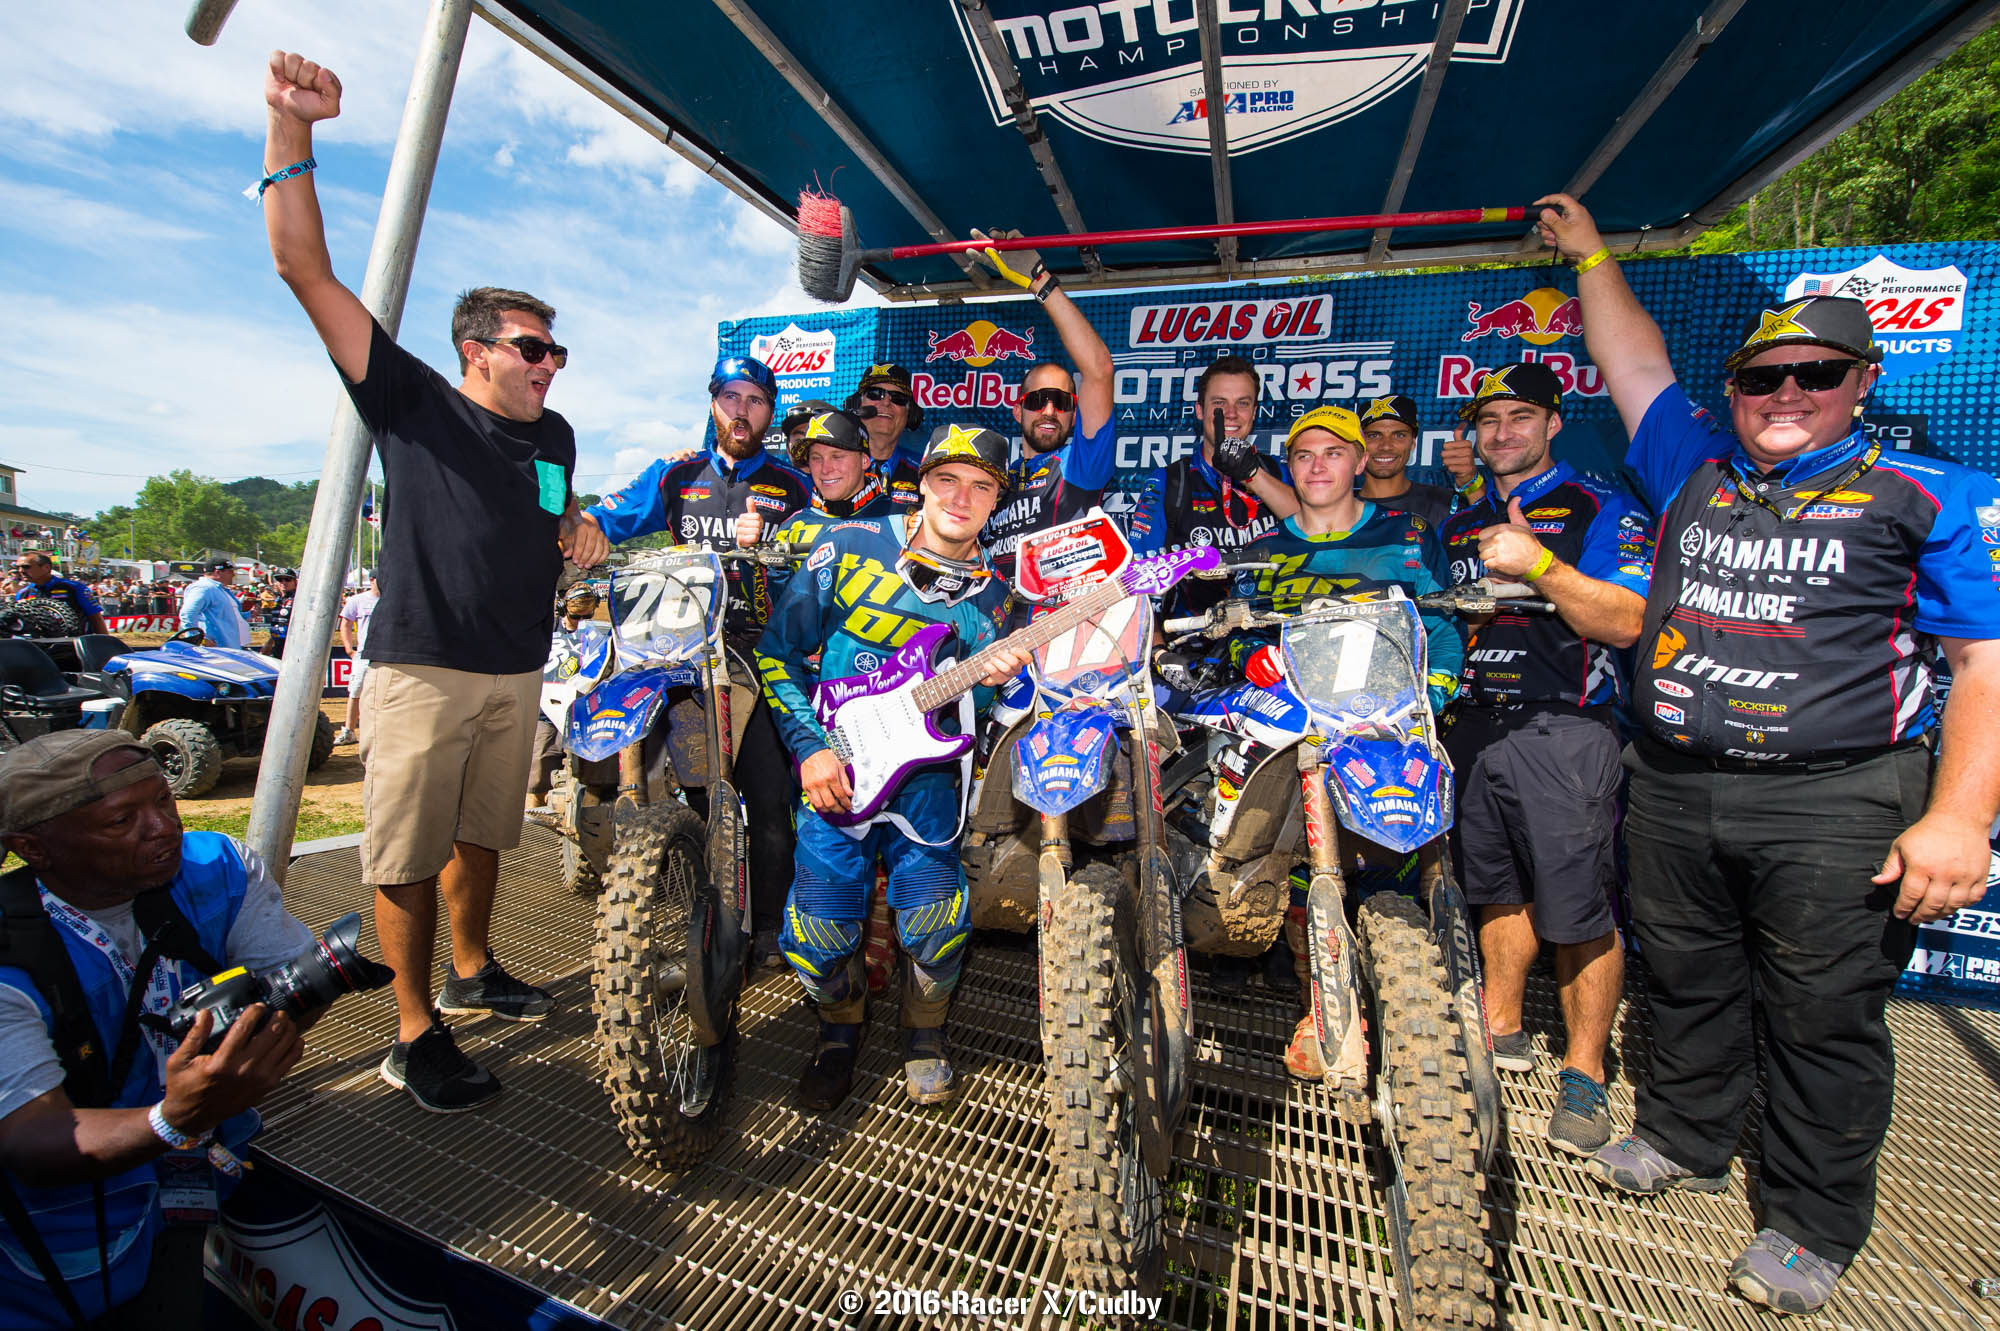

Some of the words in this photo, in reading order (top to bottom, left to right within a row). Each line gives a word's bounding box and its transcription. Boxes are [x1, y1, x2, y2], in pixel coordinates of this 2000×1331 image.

[1014, 0, 1491, 77] HAMPONSHIP
[1190, 81, 1260, 97] SAIONED
[1264, 80, 1279, 89] BY
[1250, 90, 1294, 106] PRO
[1250, 104, 1294, 113] RACING
[1881, 285, 1962, 294] PERFORMANCE
[1136, 303, 1257, 344] LUCAS
[1262, 298, 1324, 339] OIL
[1864, 297, 1955, 330] CAS
[1183, 347, 1268, 362] PRO
[1875, 338, 1952, 354] DUCTS
[765, 349, 831, 374] LUCAS
[776, 377, 831, 390] PRODUCTS
[1075, 360, 1394, 404] OTOROSS
[1437, 349, 1537, 399] Re
[1541, 352, 1609, 397] Bu
[781, 394, 802, 404] INC.
[912, 371, 978, 408] Red
[980, 370, 1023, 408] Bu
[990, 495, 1042, 531] YAMAHA
[701, 516, 778, 544] YAMHA
[1043, 529, 1071, 543] LUCAS
[1072, 525, 1086, 534] OIL
[1213, 514, 1279, 547] YAMAH
[1047, 543, 1074, 558] LUCAS
[1075, 539, 1089, 548] OIL
[1701, 527, 1846, 574] YAMAHA
[1680, 556, 1831, 586] RACING
[619, 566, 716, 641] 26
[754, 565, 768, 625] ROCKST
[1678, 576, 1798, 621] YAMALUBE
[1359, 605, 1380, 615] OIL
[107, 617, 175, 633] LUCAS
[1328, 619, 1379, 693] 1
[1469, 649, 1528, 663] hor
[1673, 653, 1800, 689] thor
[1657, 680, 1688, 696] BELL
[1246, 688, 1294, 721] YAMAHA
[1656, 704, 1681, 721] 100%
[586, 719, 627, 734] YAMAHA
[1724, 719, 1790, 733] REKLUSE
[1038, 766, 1081, 783] YAMAHA
[1368, 798, 1422, 814] YAMAHA
[786, 903, 807, 945] THOR
[1312, 904, 1345, 1042] DUNLOP
[1966, 956, 2000, 976] PR
[1965, 973, 2000, 984] RACI
